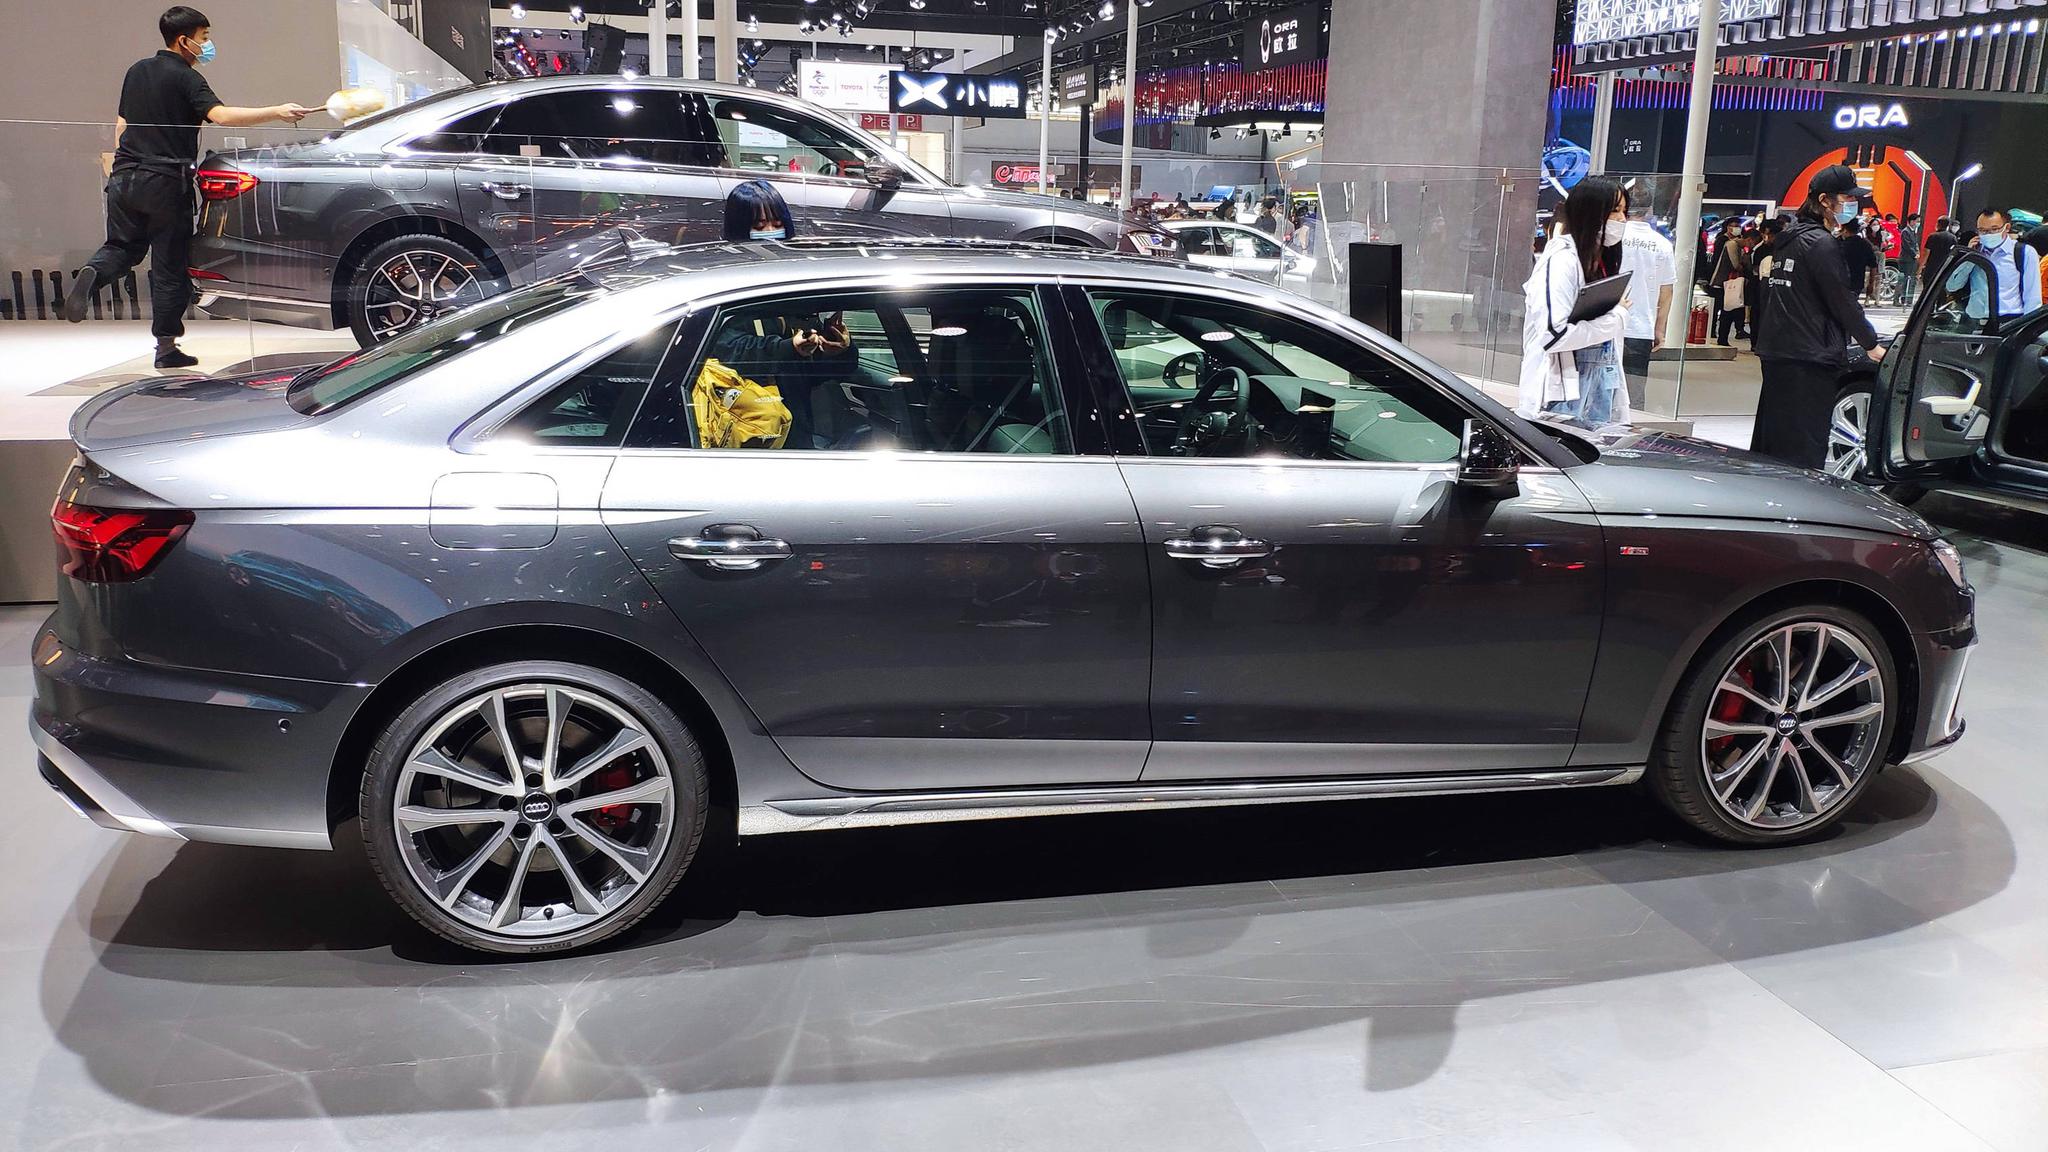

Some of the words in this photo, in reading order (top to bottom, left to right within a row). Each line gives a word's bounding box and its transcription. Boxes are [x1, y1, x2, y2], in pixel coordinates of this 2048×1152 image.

[1274, 19, 1298, 34] ORA
[1273, 33, 1298, 54] 欧拉
[906, 115, 915, 128] P
[1834, 103, 1909, 130] ORA
